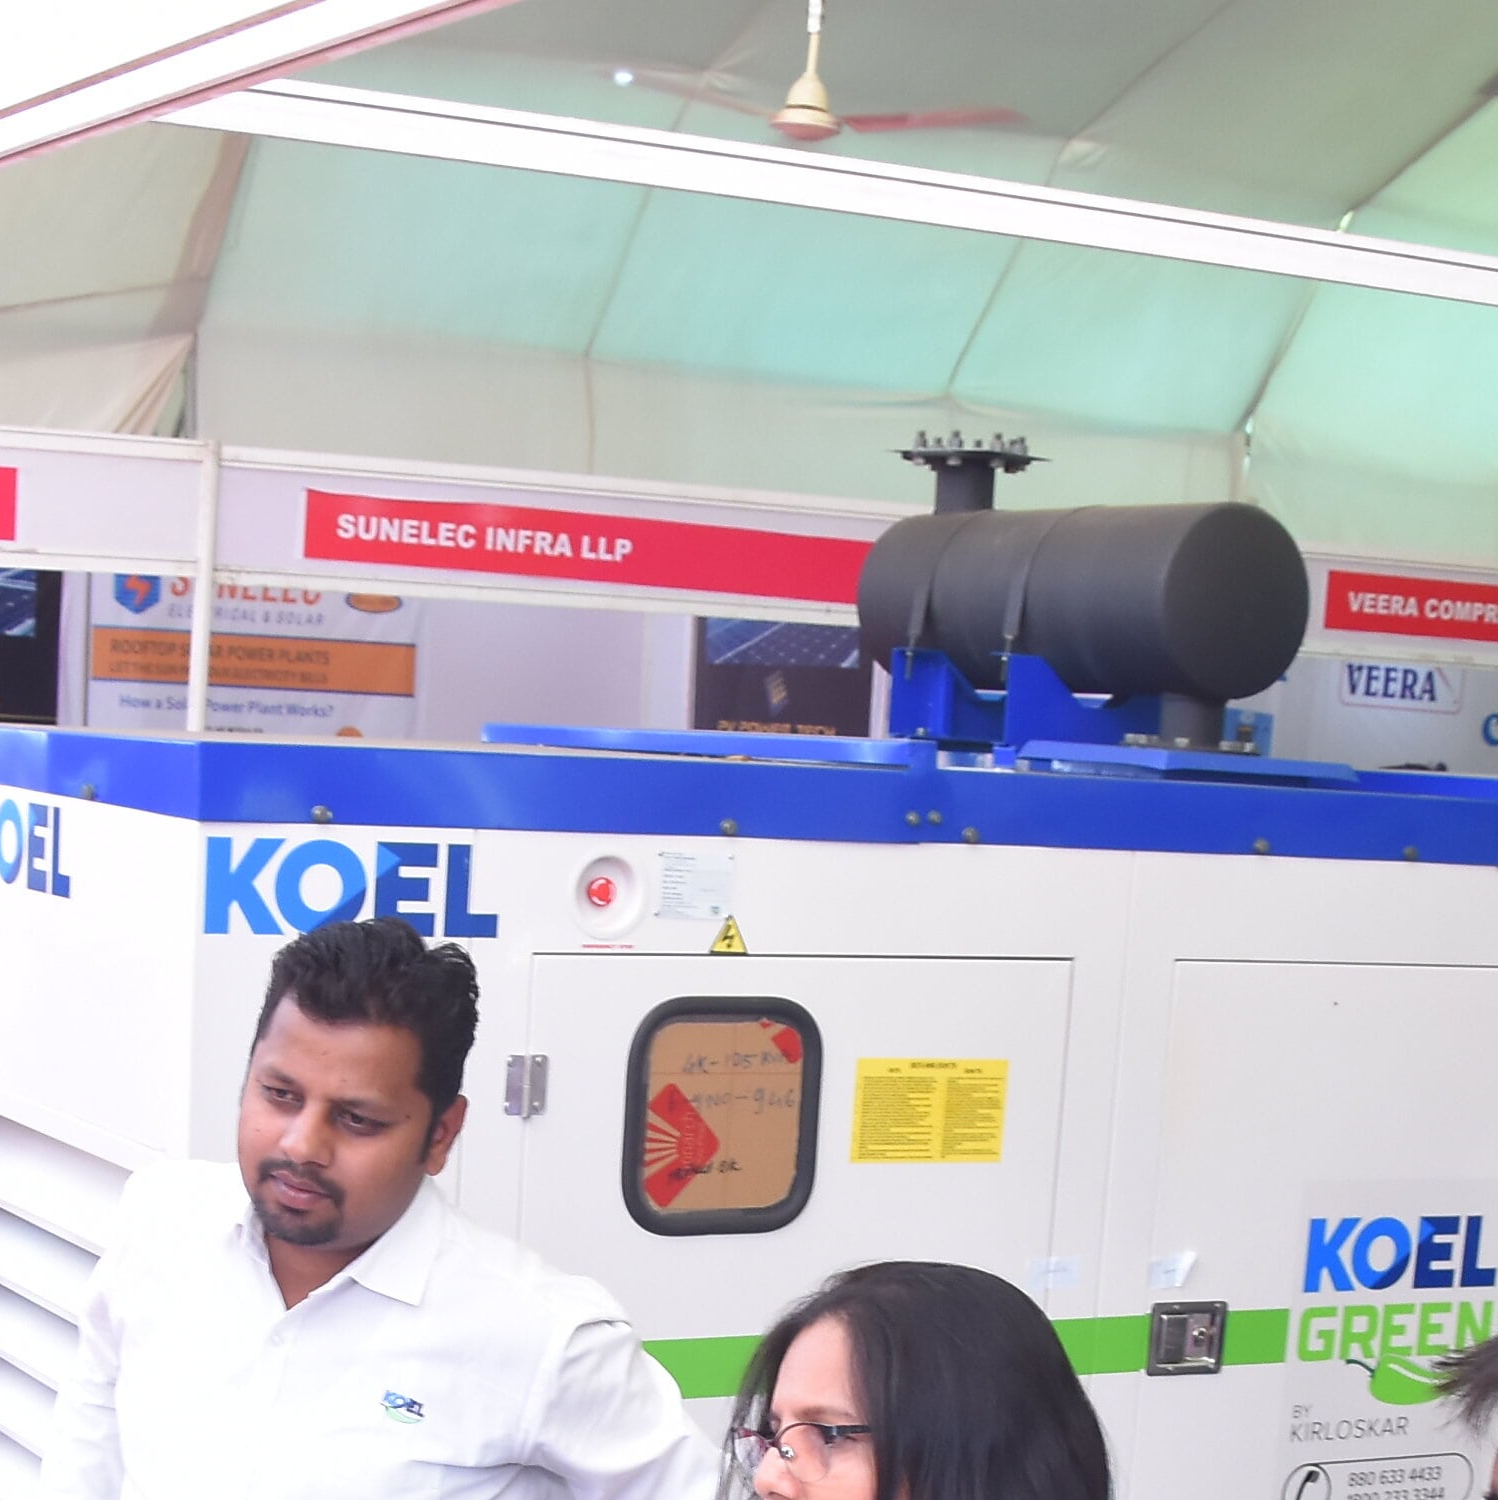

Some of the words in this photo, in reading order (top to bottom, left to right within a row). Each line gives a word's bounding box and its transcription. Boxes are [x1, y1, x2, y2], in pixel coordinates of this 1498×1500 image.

[335, 511, 477, 551] SUNELEC
[485, 524, 573, 559] INFRA
[580, 534, 634, 563] LLP
[1347, 590, 1419, 619] VEERA
[1346, 663, 1438, 702] VEERA
[118, 694, 152, 708] How
[204, 835, 497, 938] KOEL
[1304, 1215, 1497, 1293] KOEL
[1297, 1300, 1493, 1361] GREEN
[1289, 1416, 1410, 1442] KIRLOSKAR
[1293, 1405, 1311, 1419] BY
[1348, 1471, 1376, 1487] 880
[1379, 1468, 1405, 1485] 633
[1409, 1465, 1443, 1483] 4433
